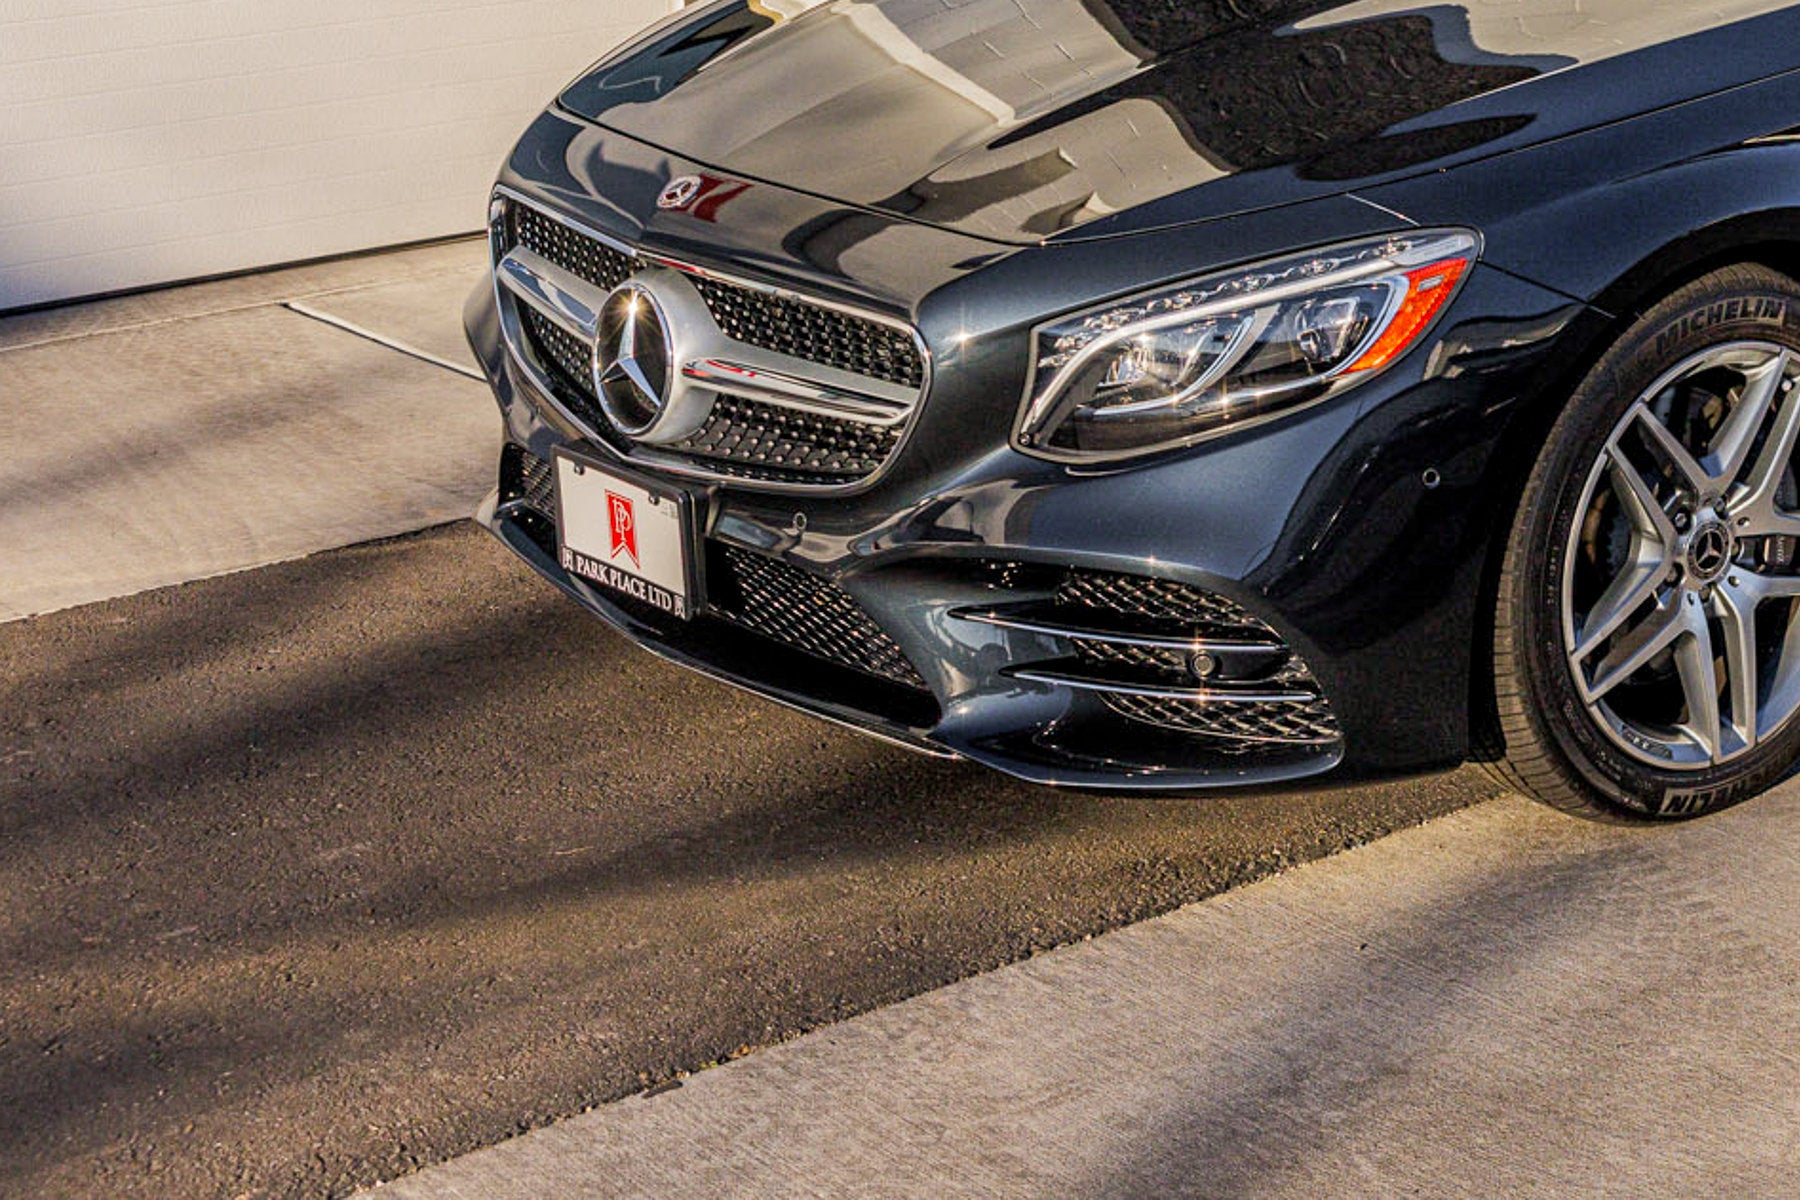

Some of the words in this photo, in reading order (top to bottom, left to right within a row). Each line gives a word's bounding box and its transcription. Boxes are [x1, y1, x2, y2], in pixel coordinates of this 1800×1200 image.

[1654, 298, 1784, 357] MICHELIN
[576, 555, 609, 584] PARK
[610, 568, 647, 600] PLACE
[647, 585, 672, 611] LTD
